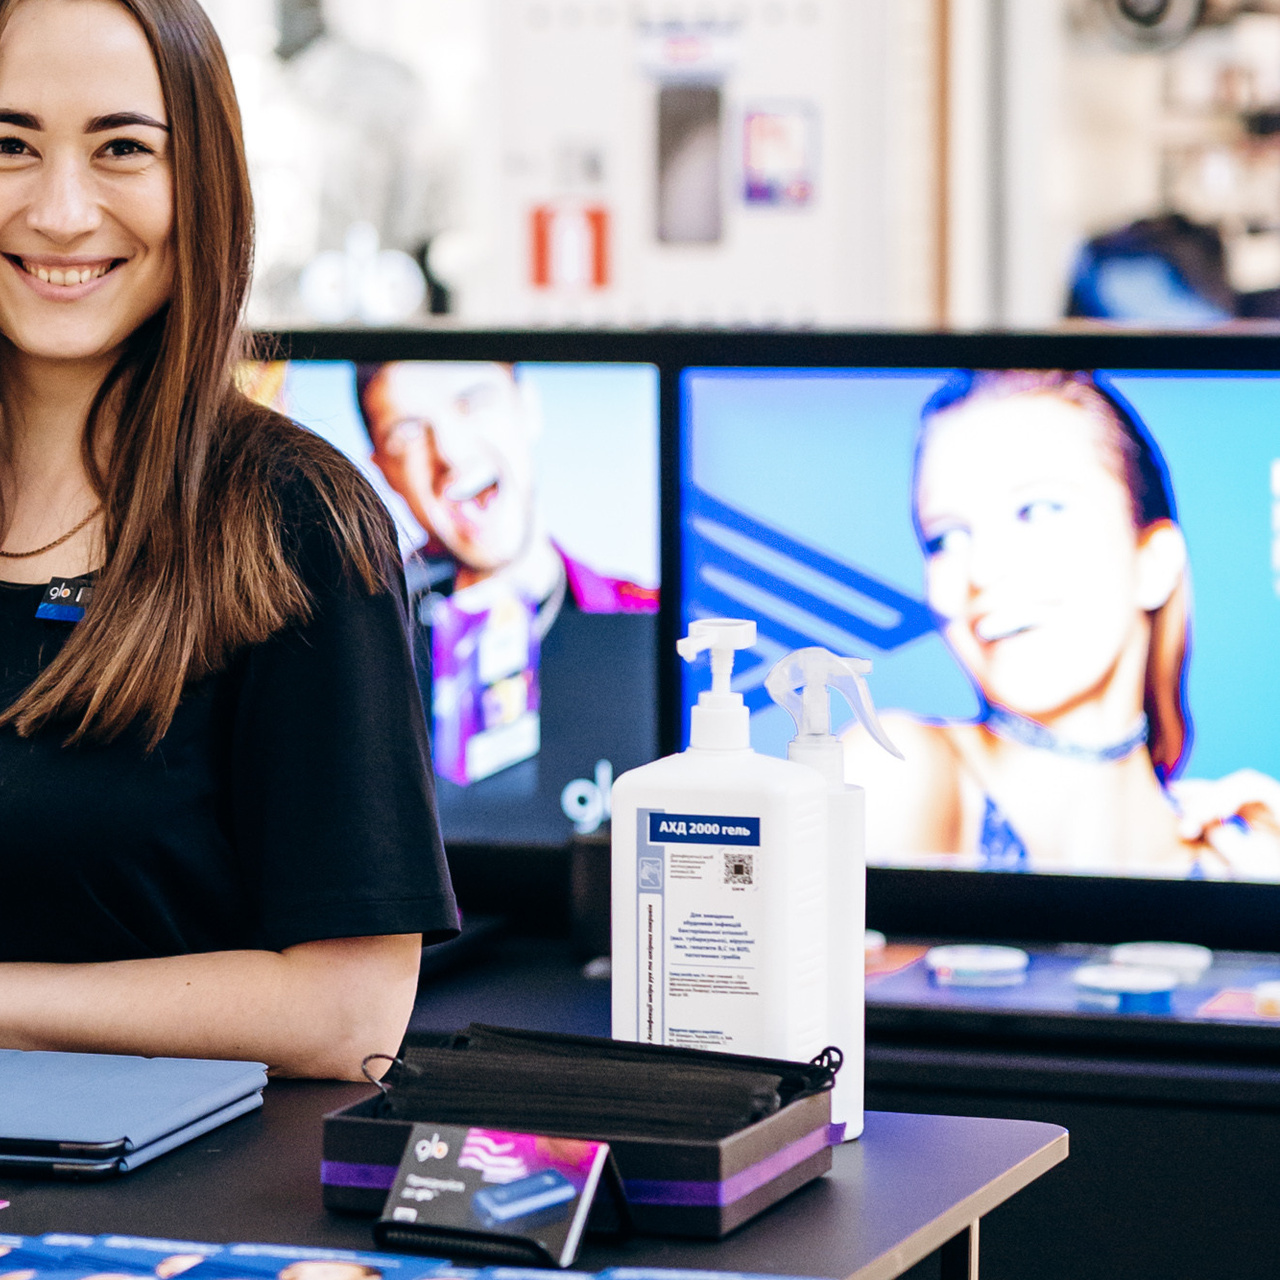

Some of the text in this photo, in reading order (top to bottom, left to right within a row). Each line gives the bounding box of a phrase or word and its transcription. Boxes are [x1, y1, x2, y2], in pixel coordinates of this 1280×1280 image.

[49, 582, 71, 600] glo
[561, 759, 612, 834] gl
[659, 821, 751, 837] АХД 2000 гель
